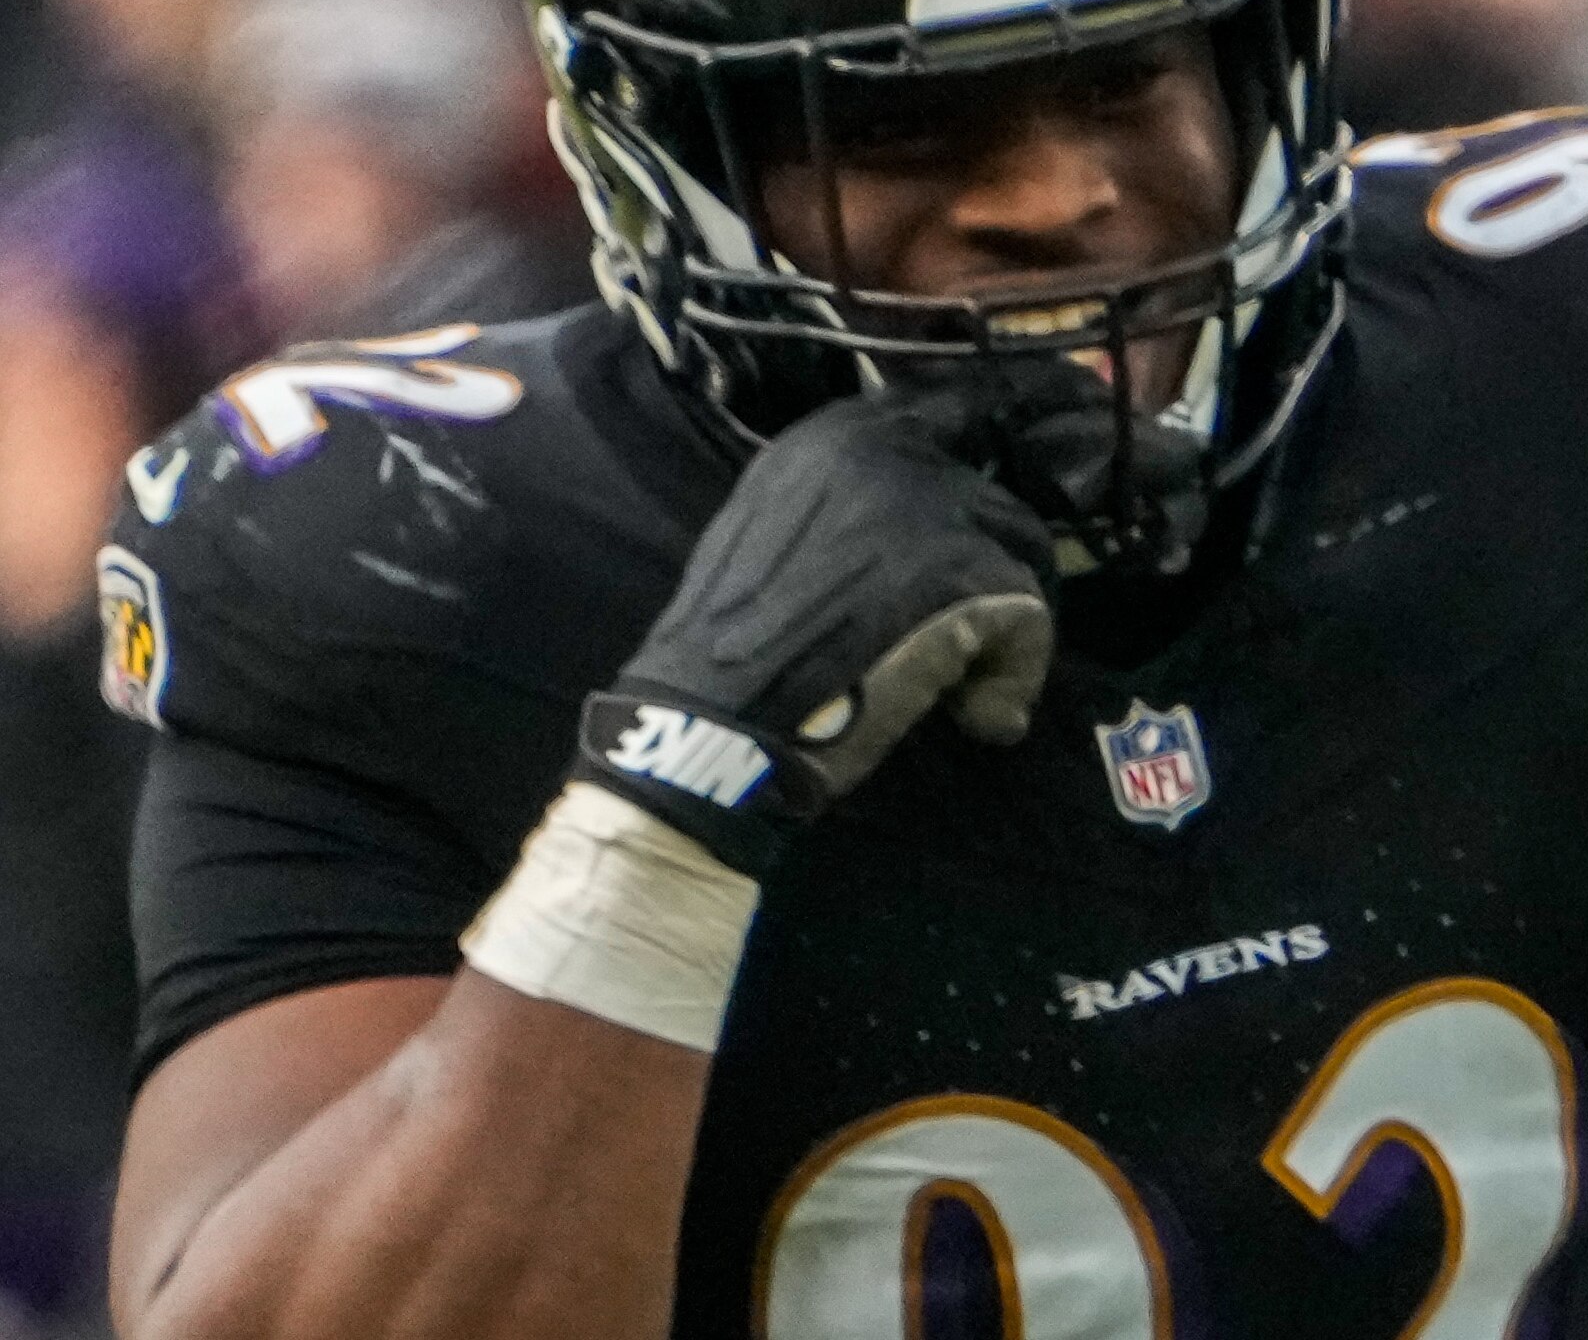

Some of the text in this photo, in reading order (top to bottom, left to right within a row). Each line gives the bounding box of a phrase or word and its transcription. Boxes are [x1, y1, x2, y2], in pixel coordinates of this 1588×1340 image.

[605, 704, 771, 810] NIKE
[1126, 754, 1196, 804] NFL
[1060, 924, 1330, 1021] RAVENS
